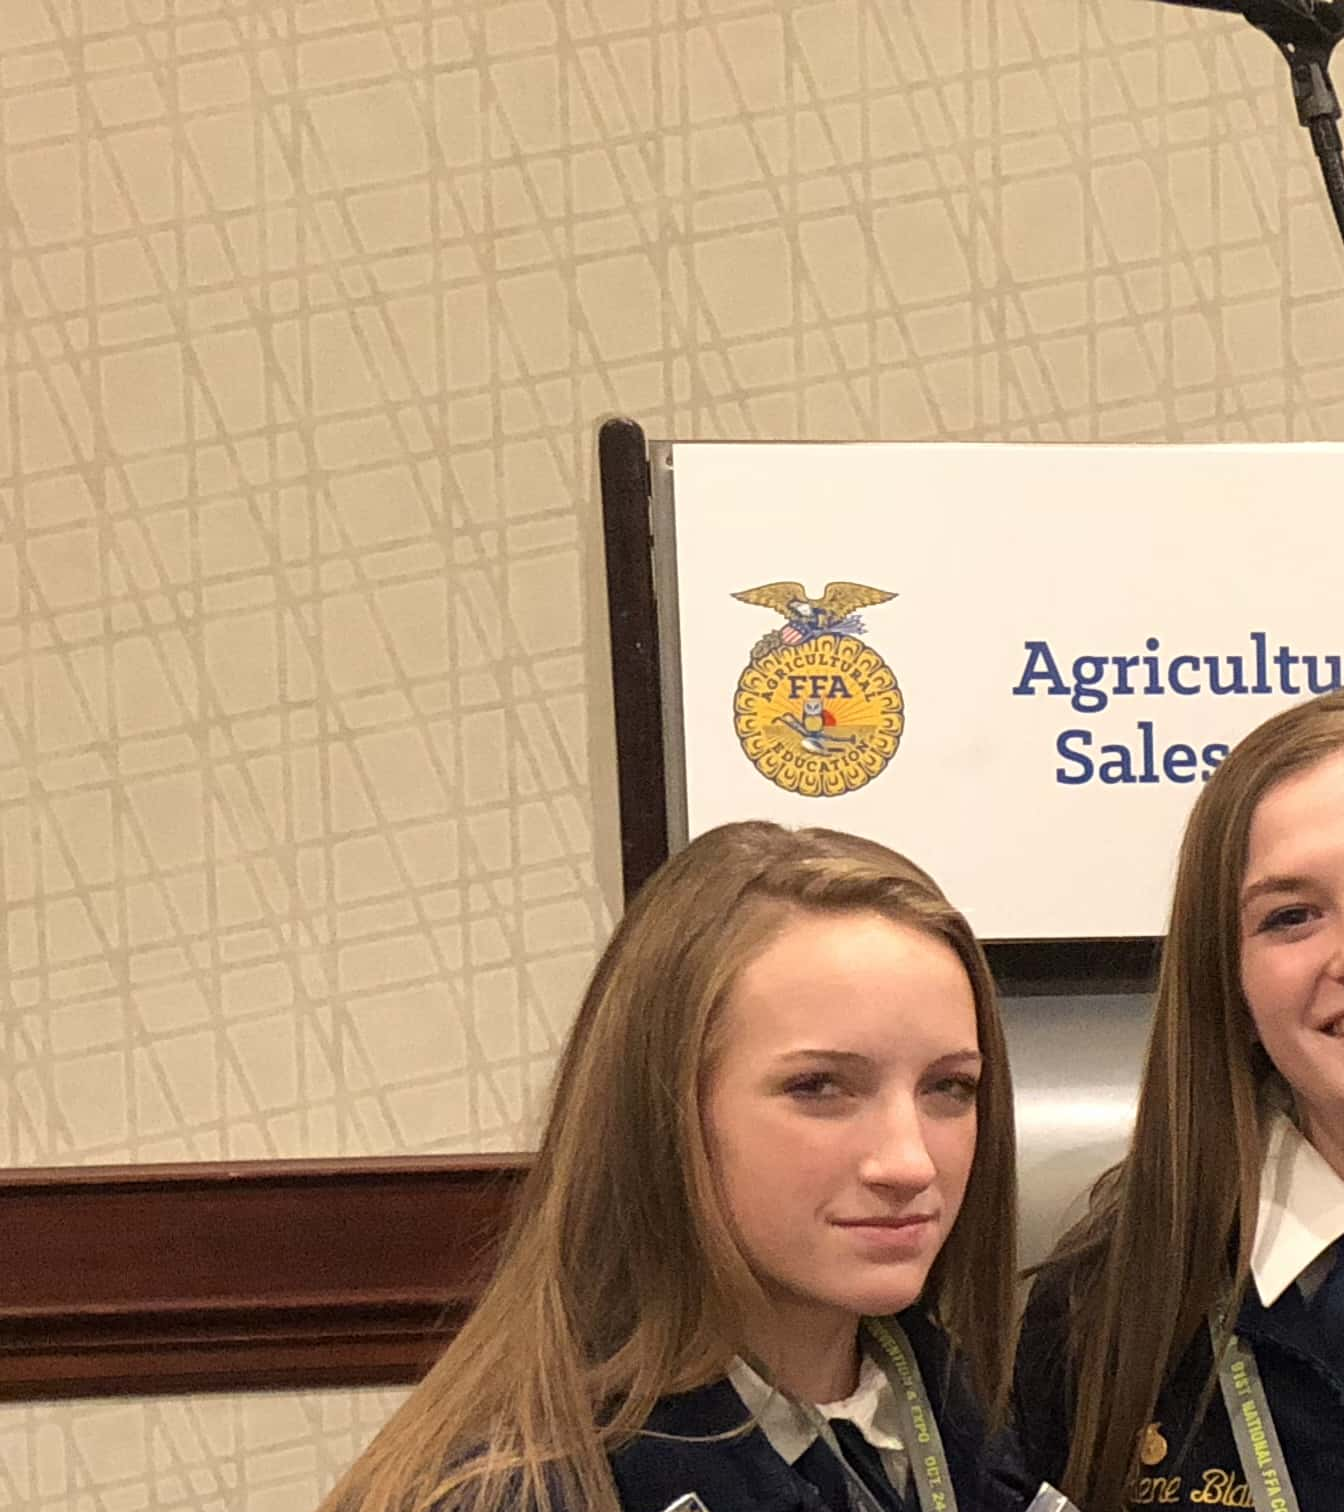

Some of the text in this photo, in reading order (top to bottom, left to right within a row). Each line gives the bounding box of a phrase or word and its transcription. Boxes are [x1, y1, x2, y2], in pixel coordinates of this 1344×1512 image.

[761, 653, 876, 703] AGRICULTURAL
[788, 675, 853, 699] FFA
[772, 740, 871, 773] EDUCATION
[1055, 721, 1229, 785] Sales
[1241, 1399, 1273, 1469] NATIONAL
[1262, 1469, 1282, 1498] FFA
